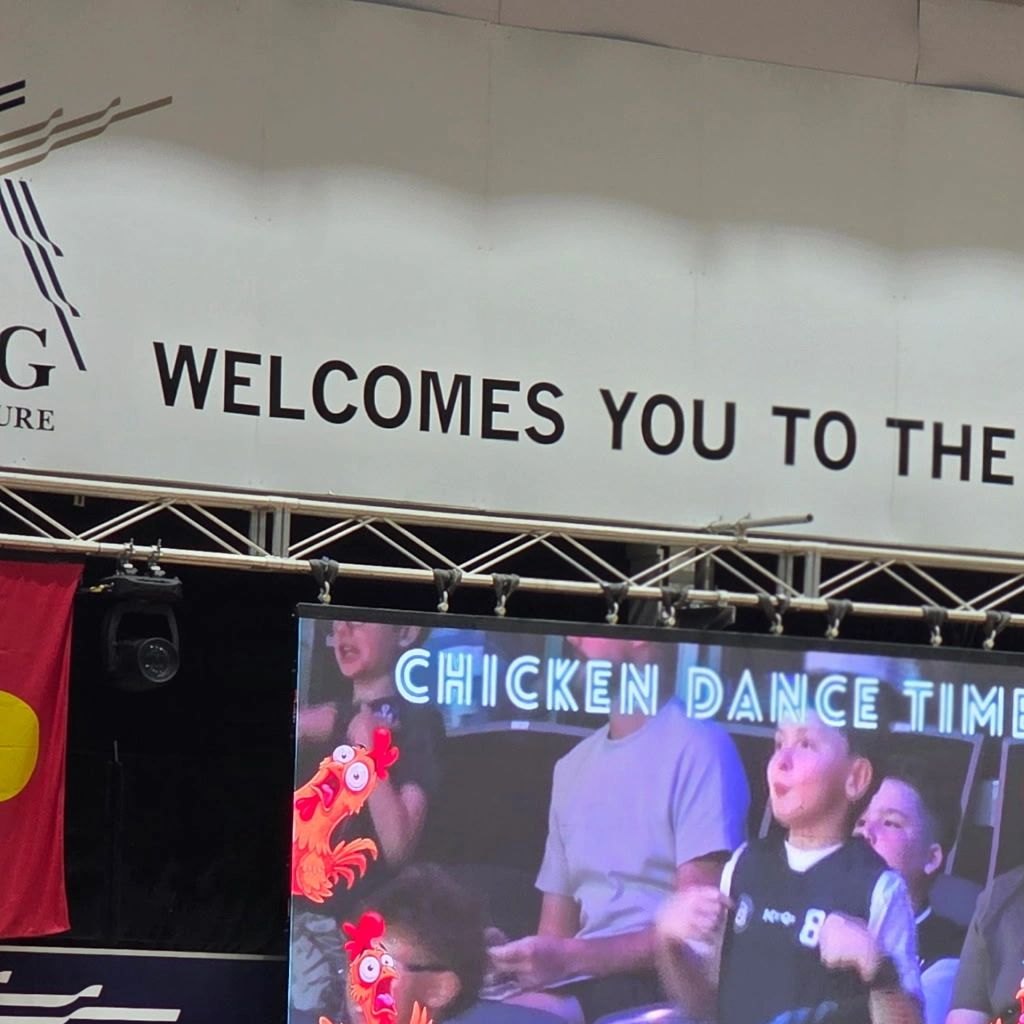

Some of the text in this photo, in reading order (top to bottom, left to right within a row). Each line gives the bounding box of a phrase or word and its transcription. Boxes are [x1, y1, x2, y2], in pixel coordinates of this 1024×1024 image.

[153, 341, 565, 445] WELCOMES
[599, 388, 736, 460] YOU
[772, 405, 857, 470] TO
[886, 417, 1016, 486] THE
[395, 648, 659, 717] CHICKEN
[686, 666, 879, 731] DANCE
